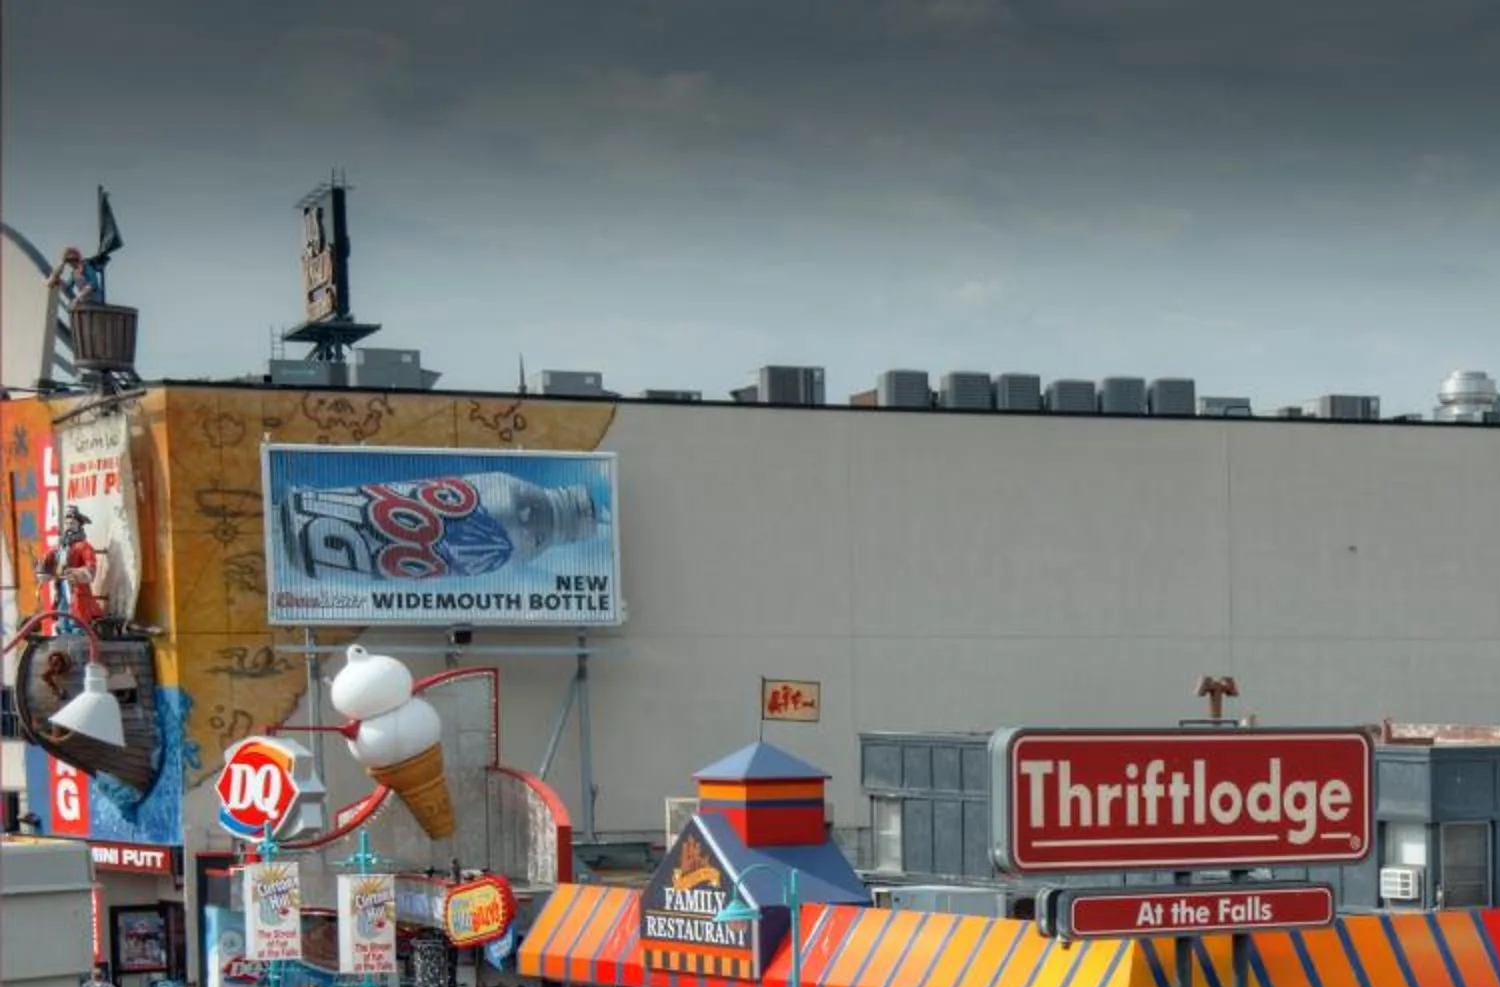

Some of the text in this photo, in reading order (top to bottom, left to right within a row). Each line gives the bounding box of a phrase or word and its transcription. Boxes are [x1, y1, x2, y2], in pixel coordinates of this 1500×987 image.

[555, 574, 608, 592] NEW
[371, 591, 610, 611] WIDEMOUTH BOTTLE
[227, 763, 281, 819] DQ
[1019, 757, 1353, 845] Thriftlodge
[122, 848, 164, 868] PUTT
[664, 887, 726, 917] FAMILY
[1136, 896, 1273, 927] At the Falls
